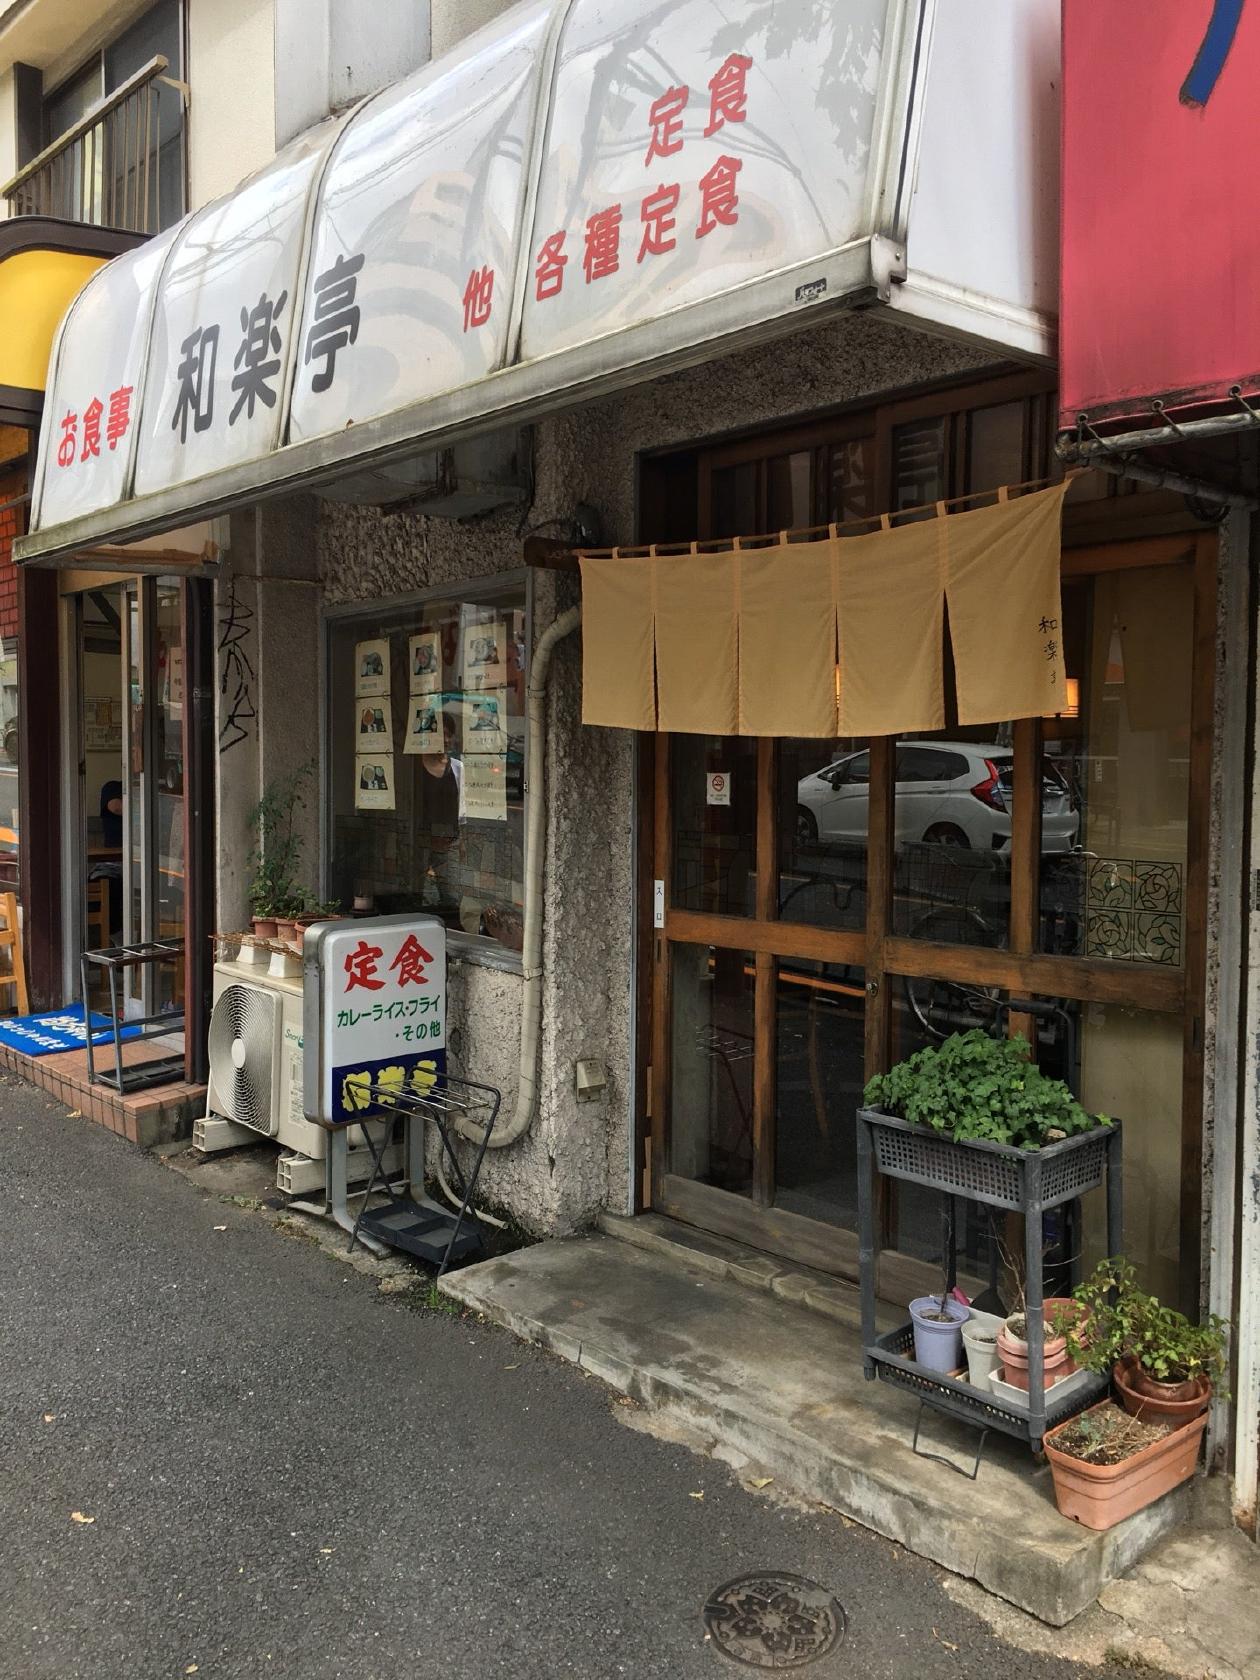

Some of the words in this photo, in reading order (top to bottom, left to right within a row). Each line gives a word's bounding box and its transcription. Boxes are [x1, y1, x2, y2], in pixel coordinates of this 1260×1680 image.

[645, 52, 753, 167] 定食
[463, 265, 494, 333] 他
[535, 154, 743, 301] 各種定食
[171, 252, 365, 444] 和楽亭
[57, 385, 134, 467] お食事
[337, 994, 441, 1028] カレーライス・フライ
[343, 934, 435, 993] 定食
